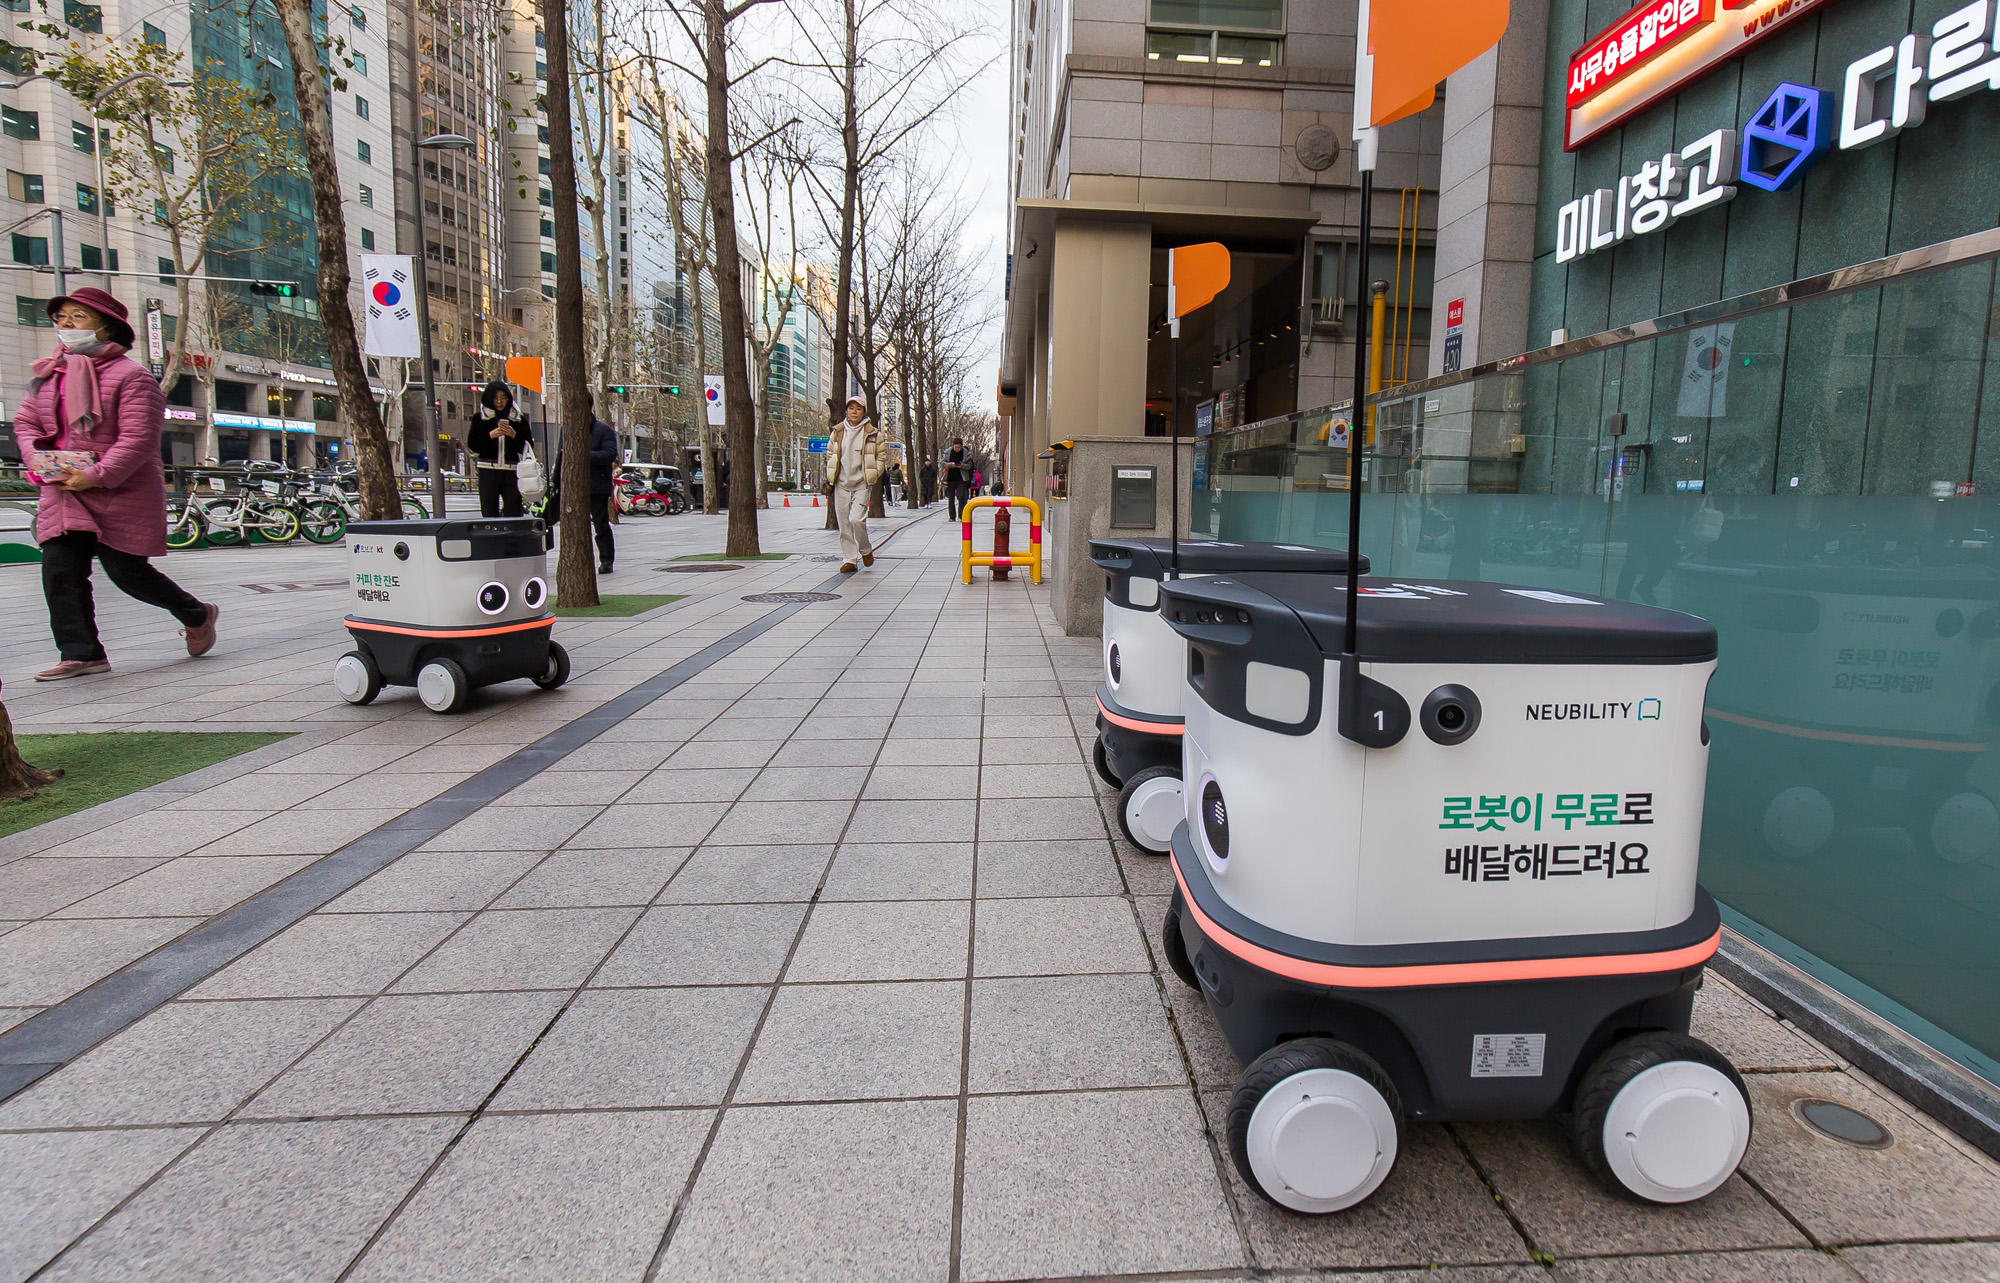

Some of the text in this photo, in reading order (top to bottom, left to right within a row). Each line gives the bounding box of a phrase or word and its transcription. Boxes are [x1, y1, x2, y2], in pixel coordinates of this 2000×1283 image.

[1743, 0, 1811, 37] www.
[1556, 129, 1730, 264] 미니창고
[1444, 348, 1460, 373] 420
[376, 545, 384, 554] kt
[356, 573, 401, 588] 커피 한 잔도
[357, 588, 391, 602] 배달해요
[1373, 710, 1384, 731] 1
[1525, 702, 1632, 721] NEUBILITY
[1438, 792, 1654, 832] 로봇이 무료로
[1444, 841, 1650, 882] 배달해드려요
